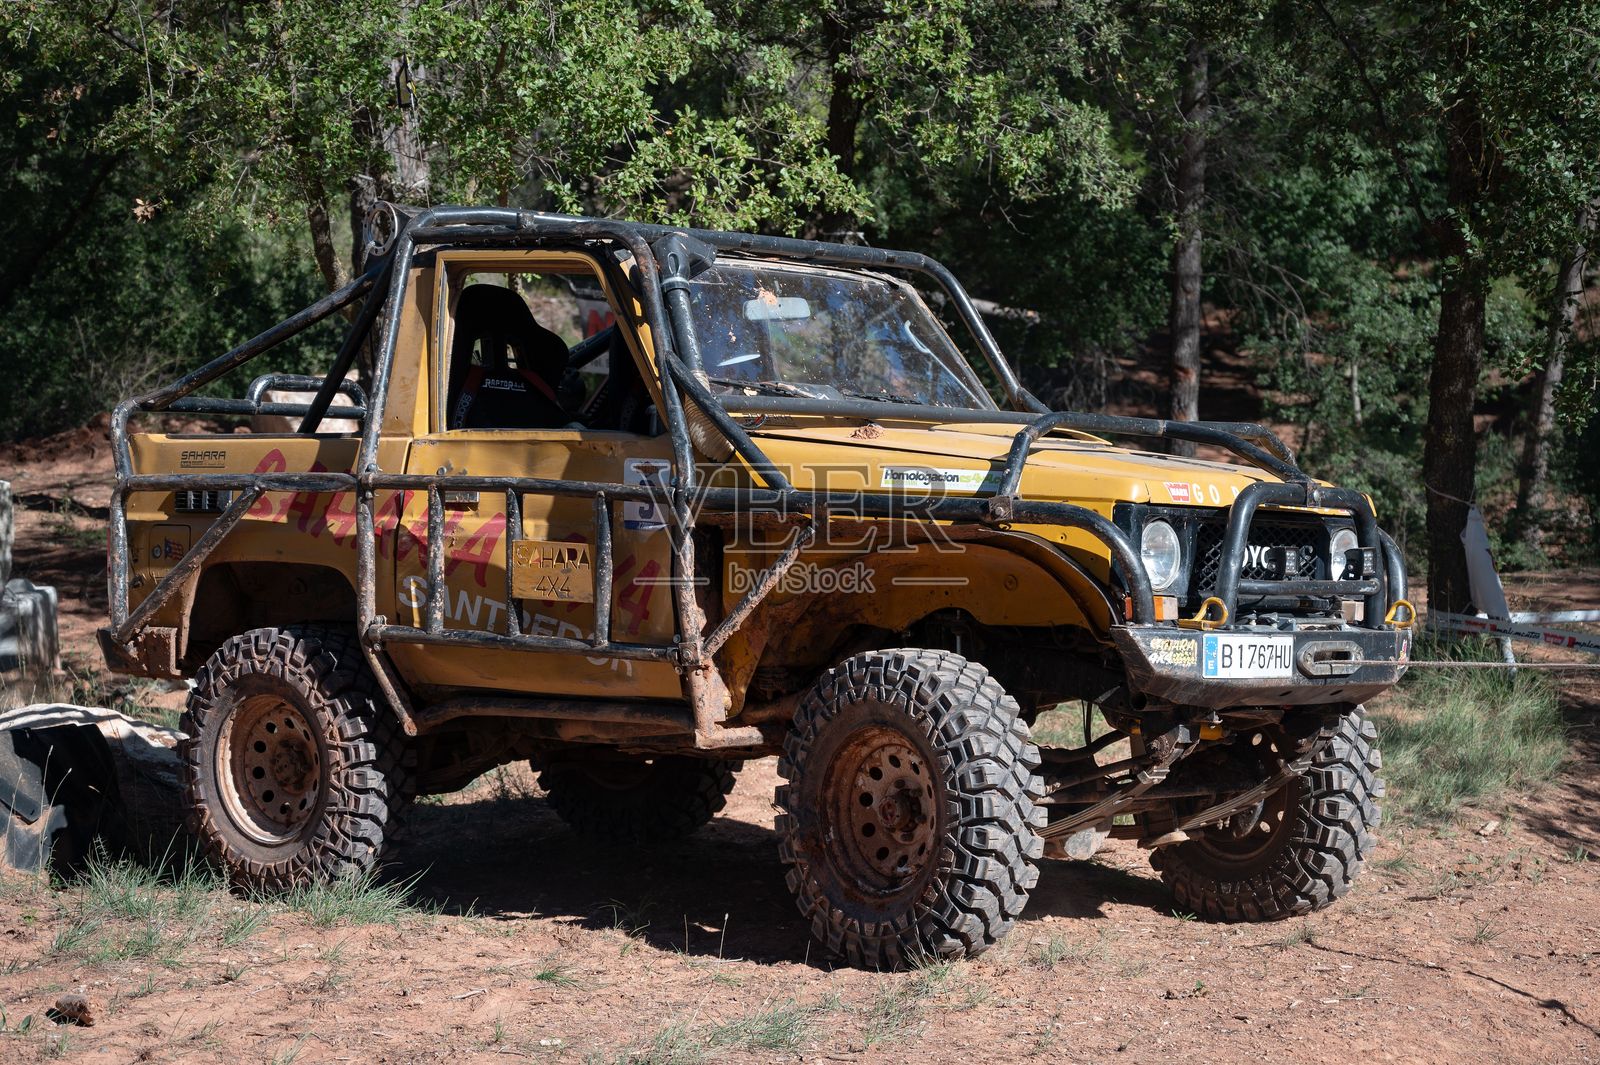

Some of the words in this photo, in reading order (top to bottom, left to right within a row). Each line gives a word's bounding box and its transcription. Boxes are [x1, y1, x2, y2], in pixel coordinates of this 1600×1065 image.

[181, 451, 226, 460] SAHARA
[516, 544, 590, 570] SAHARA
[534, 575, 571, 598] 4X4
[1207, 660, 1215, 670] E
